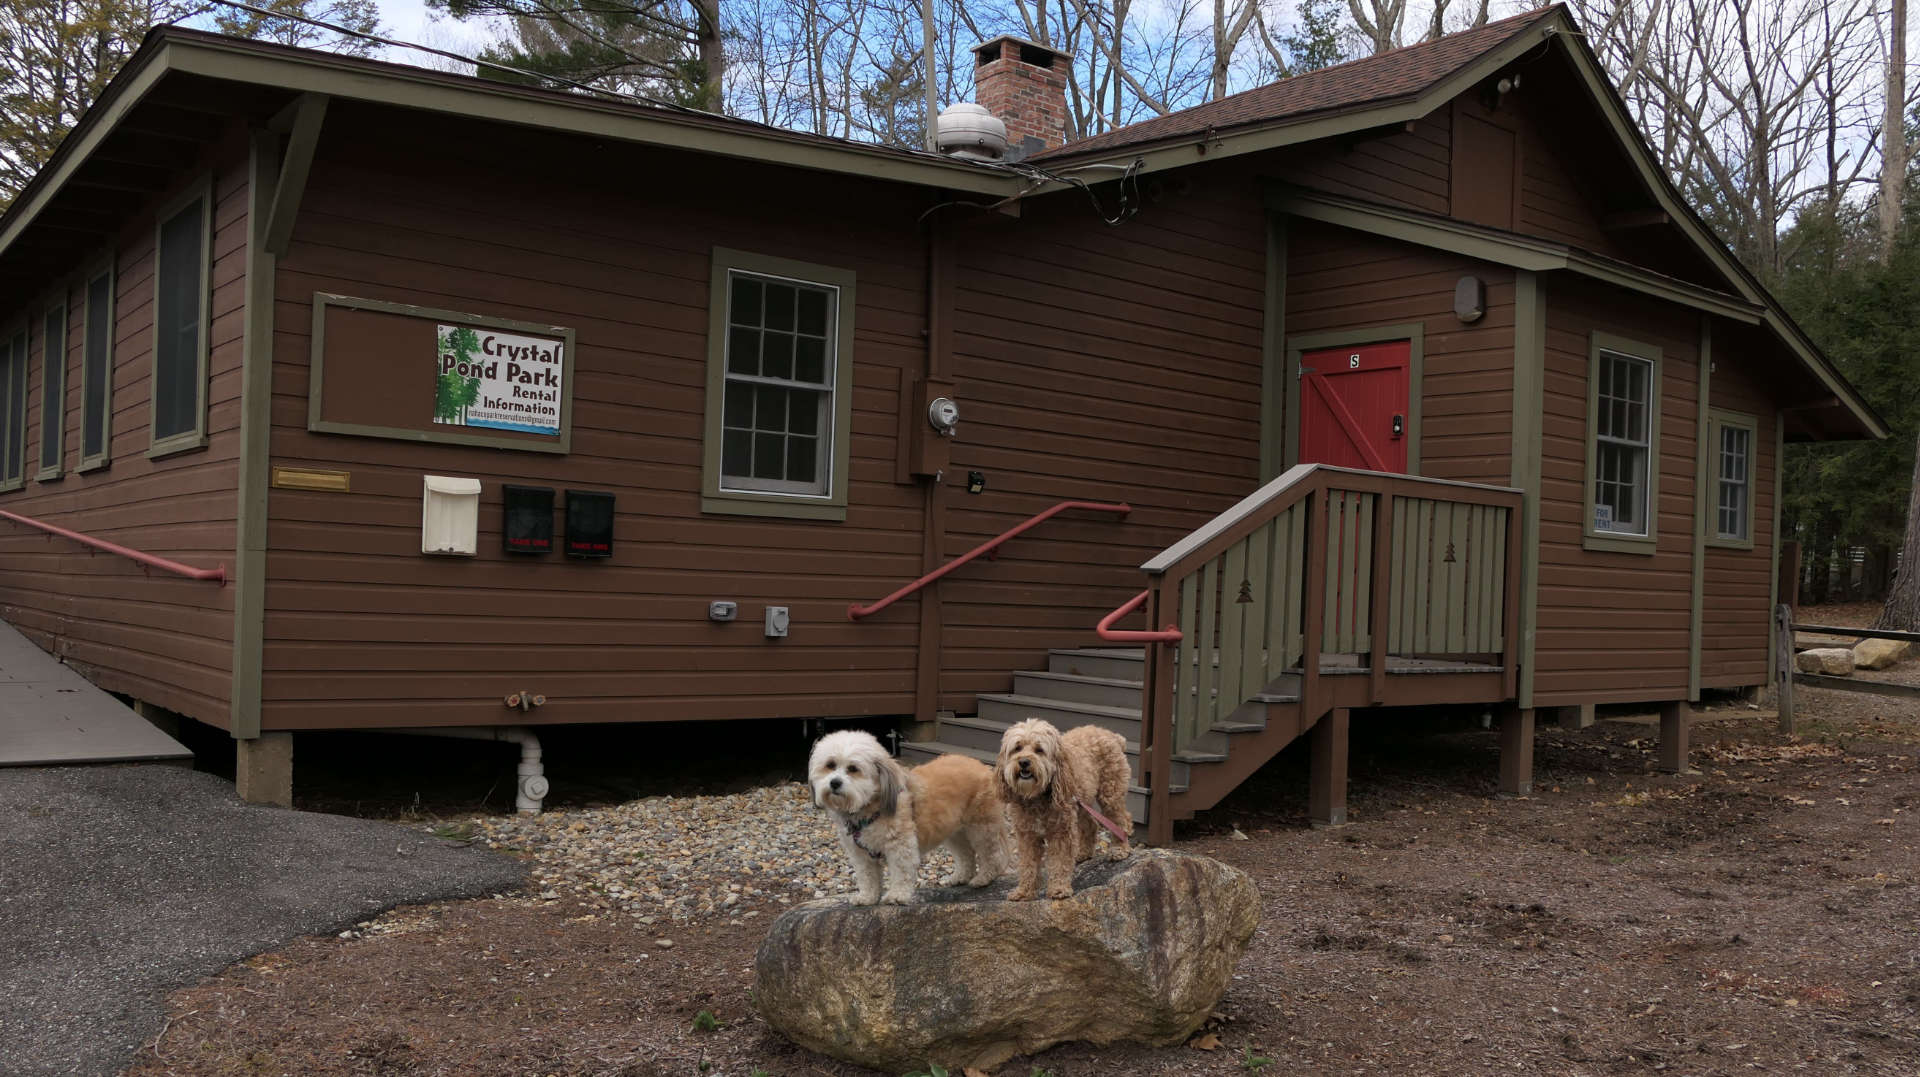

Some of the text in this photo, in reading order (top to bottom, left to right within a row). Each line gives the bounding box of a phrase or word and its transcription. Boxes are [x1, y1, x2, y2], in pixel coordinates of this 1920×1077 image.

[482, 335, 560, 364] Crystal
[442, 354, 559, 388] Pond Park
[512, 385, 557, 402] Rental
[483, 396, 556, 416] Information
